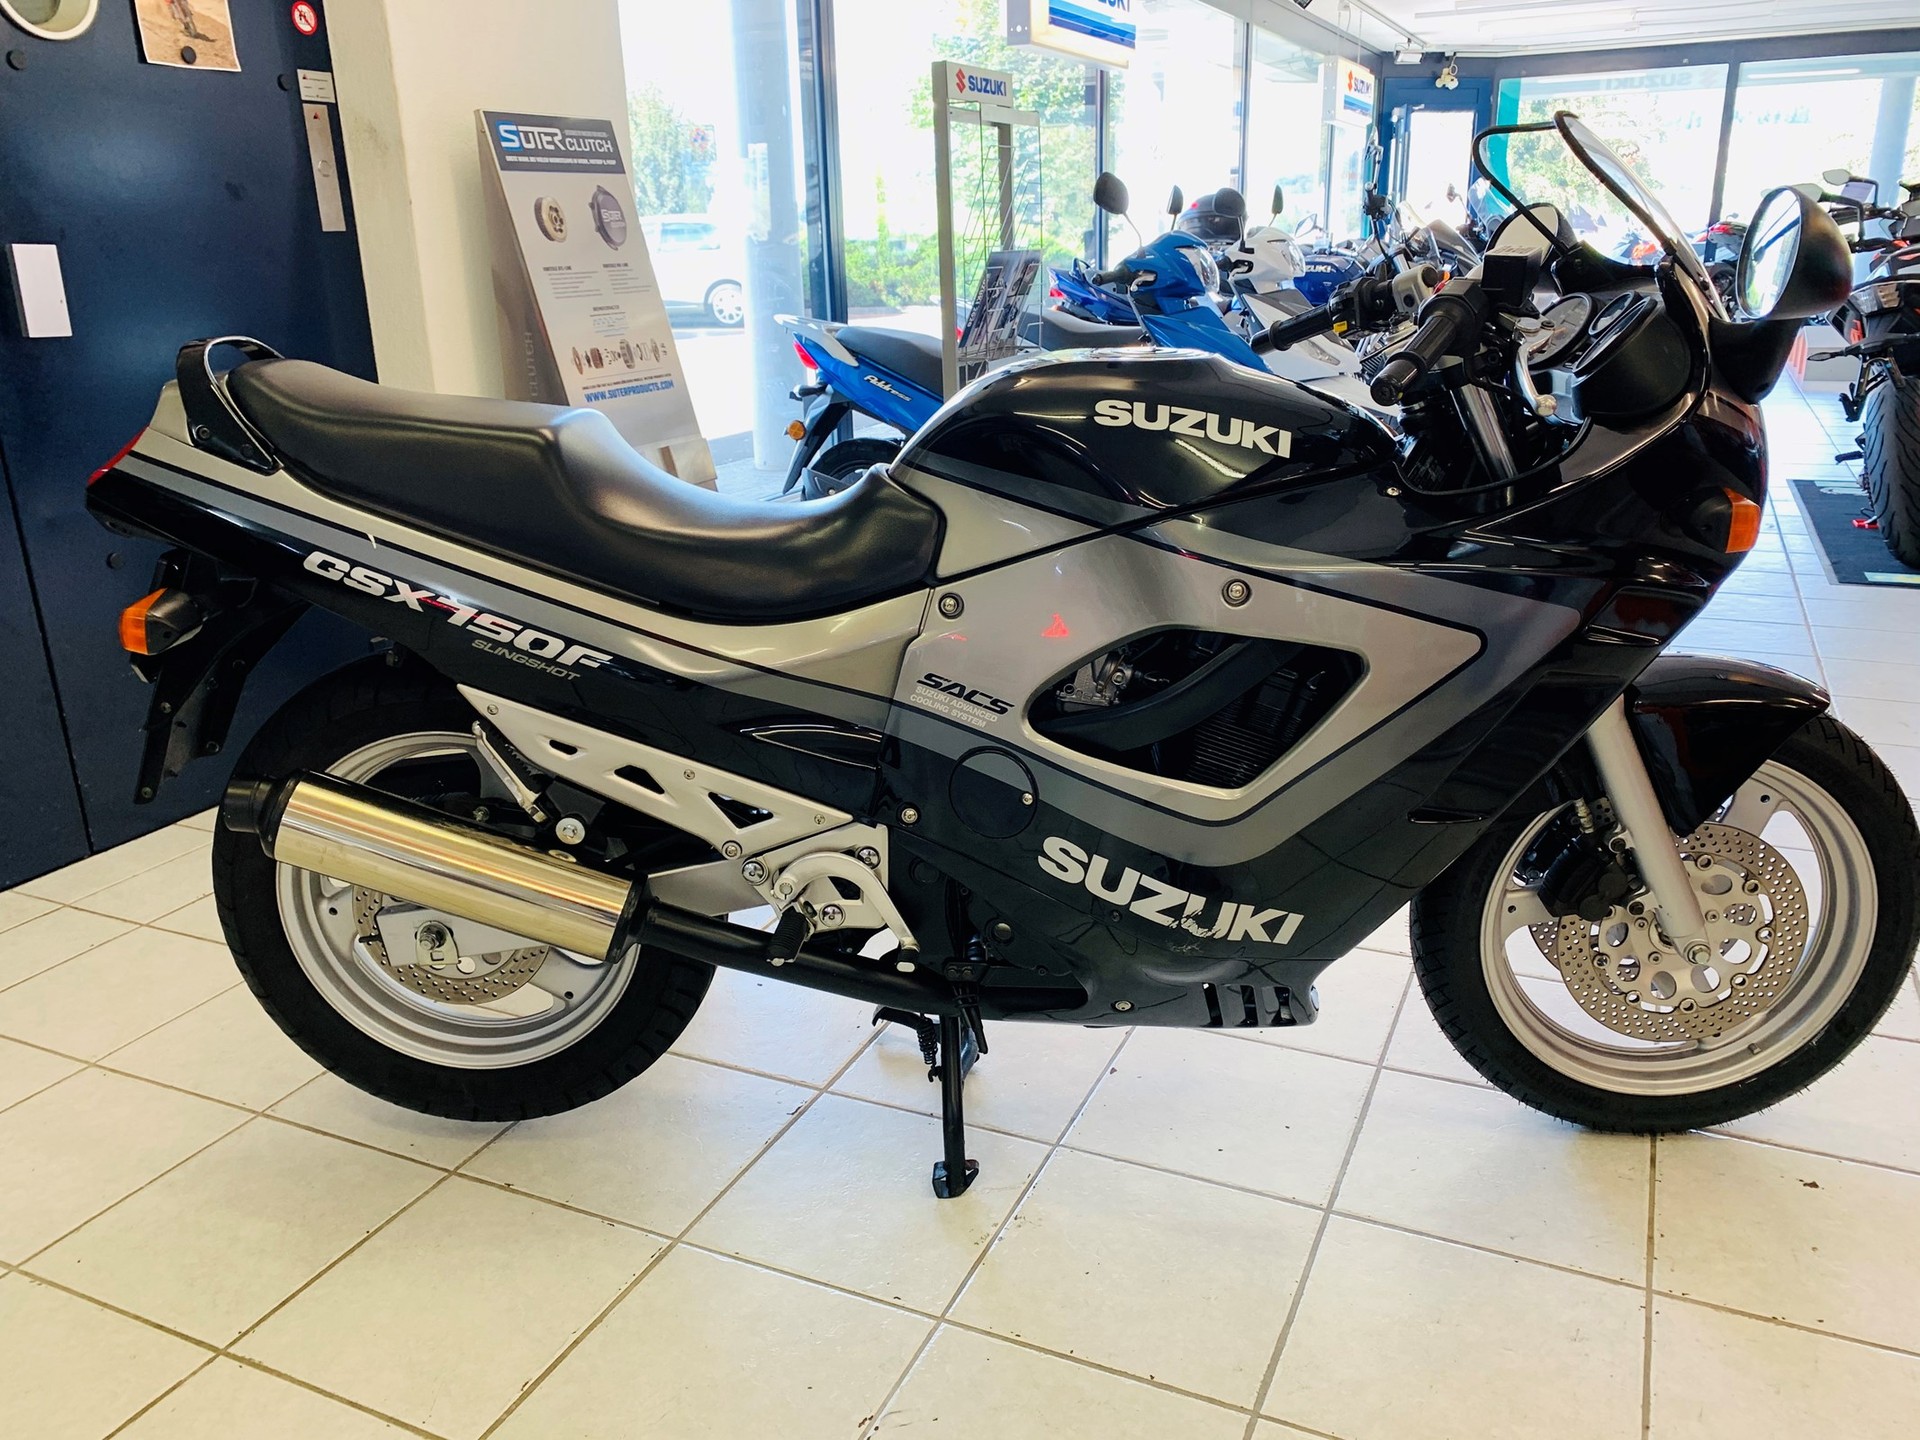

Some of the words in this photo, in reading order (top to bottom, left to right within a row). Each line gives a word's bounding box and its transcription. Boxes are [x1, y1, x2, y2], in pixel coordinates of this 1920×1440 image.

[968, 74, 1007, 97] SUZUKI
[566, 137, 614, 153] CLUTCH
[584, 380, 675, 403] WWW.SUTERPRODUCTS.COM
[864, 374, 912, 402] Address
[1093, 399, 1292, 459] SUZUKI
[472, 638, 581, 681] SLINGSHOT
[910, 694, 950, 713] COOLING
[950, 709, 987, 728] SYSTEM
[915, 686, 950, 703] SUZUKI
[950, 699, 998, 723] ADVANCED
[916, 672, 1015, 715] SACS
[1037, 836, 1305, 945] SUZUKI
